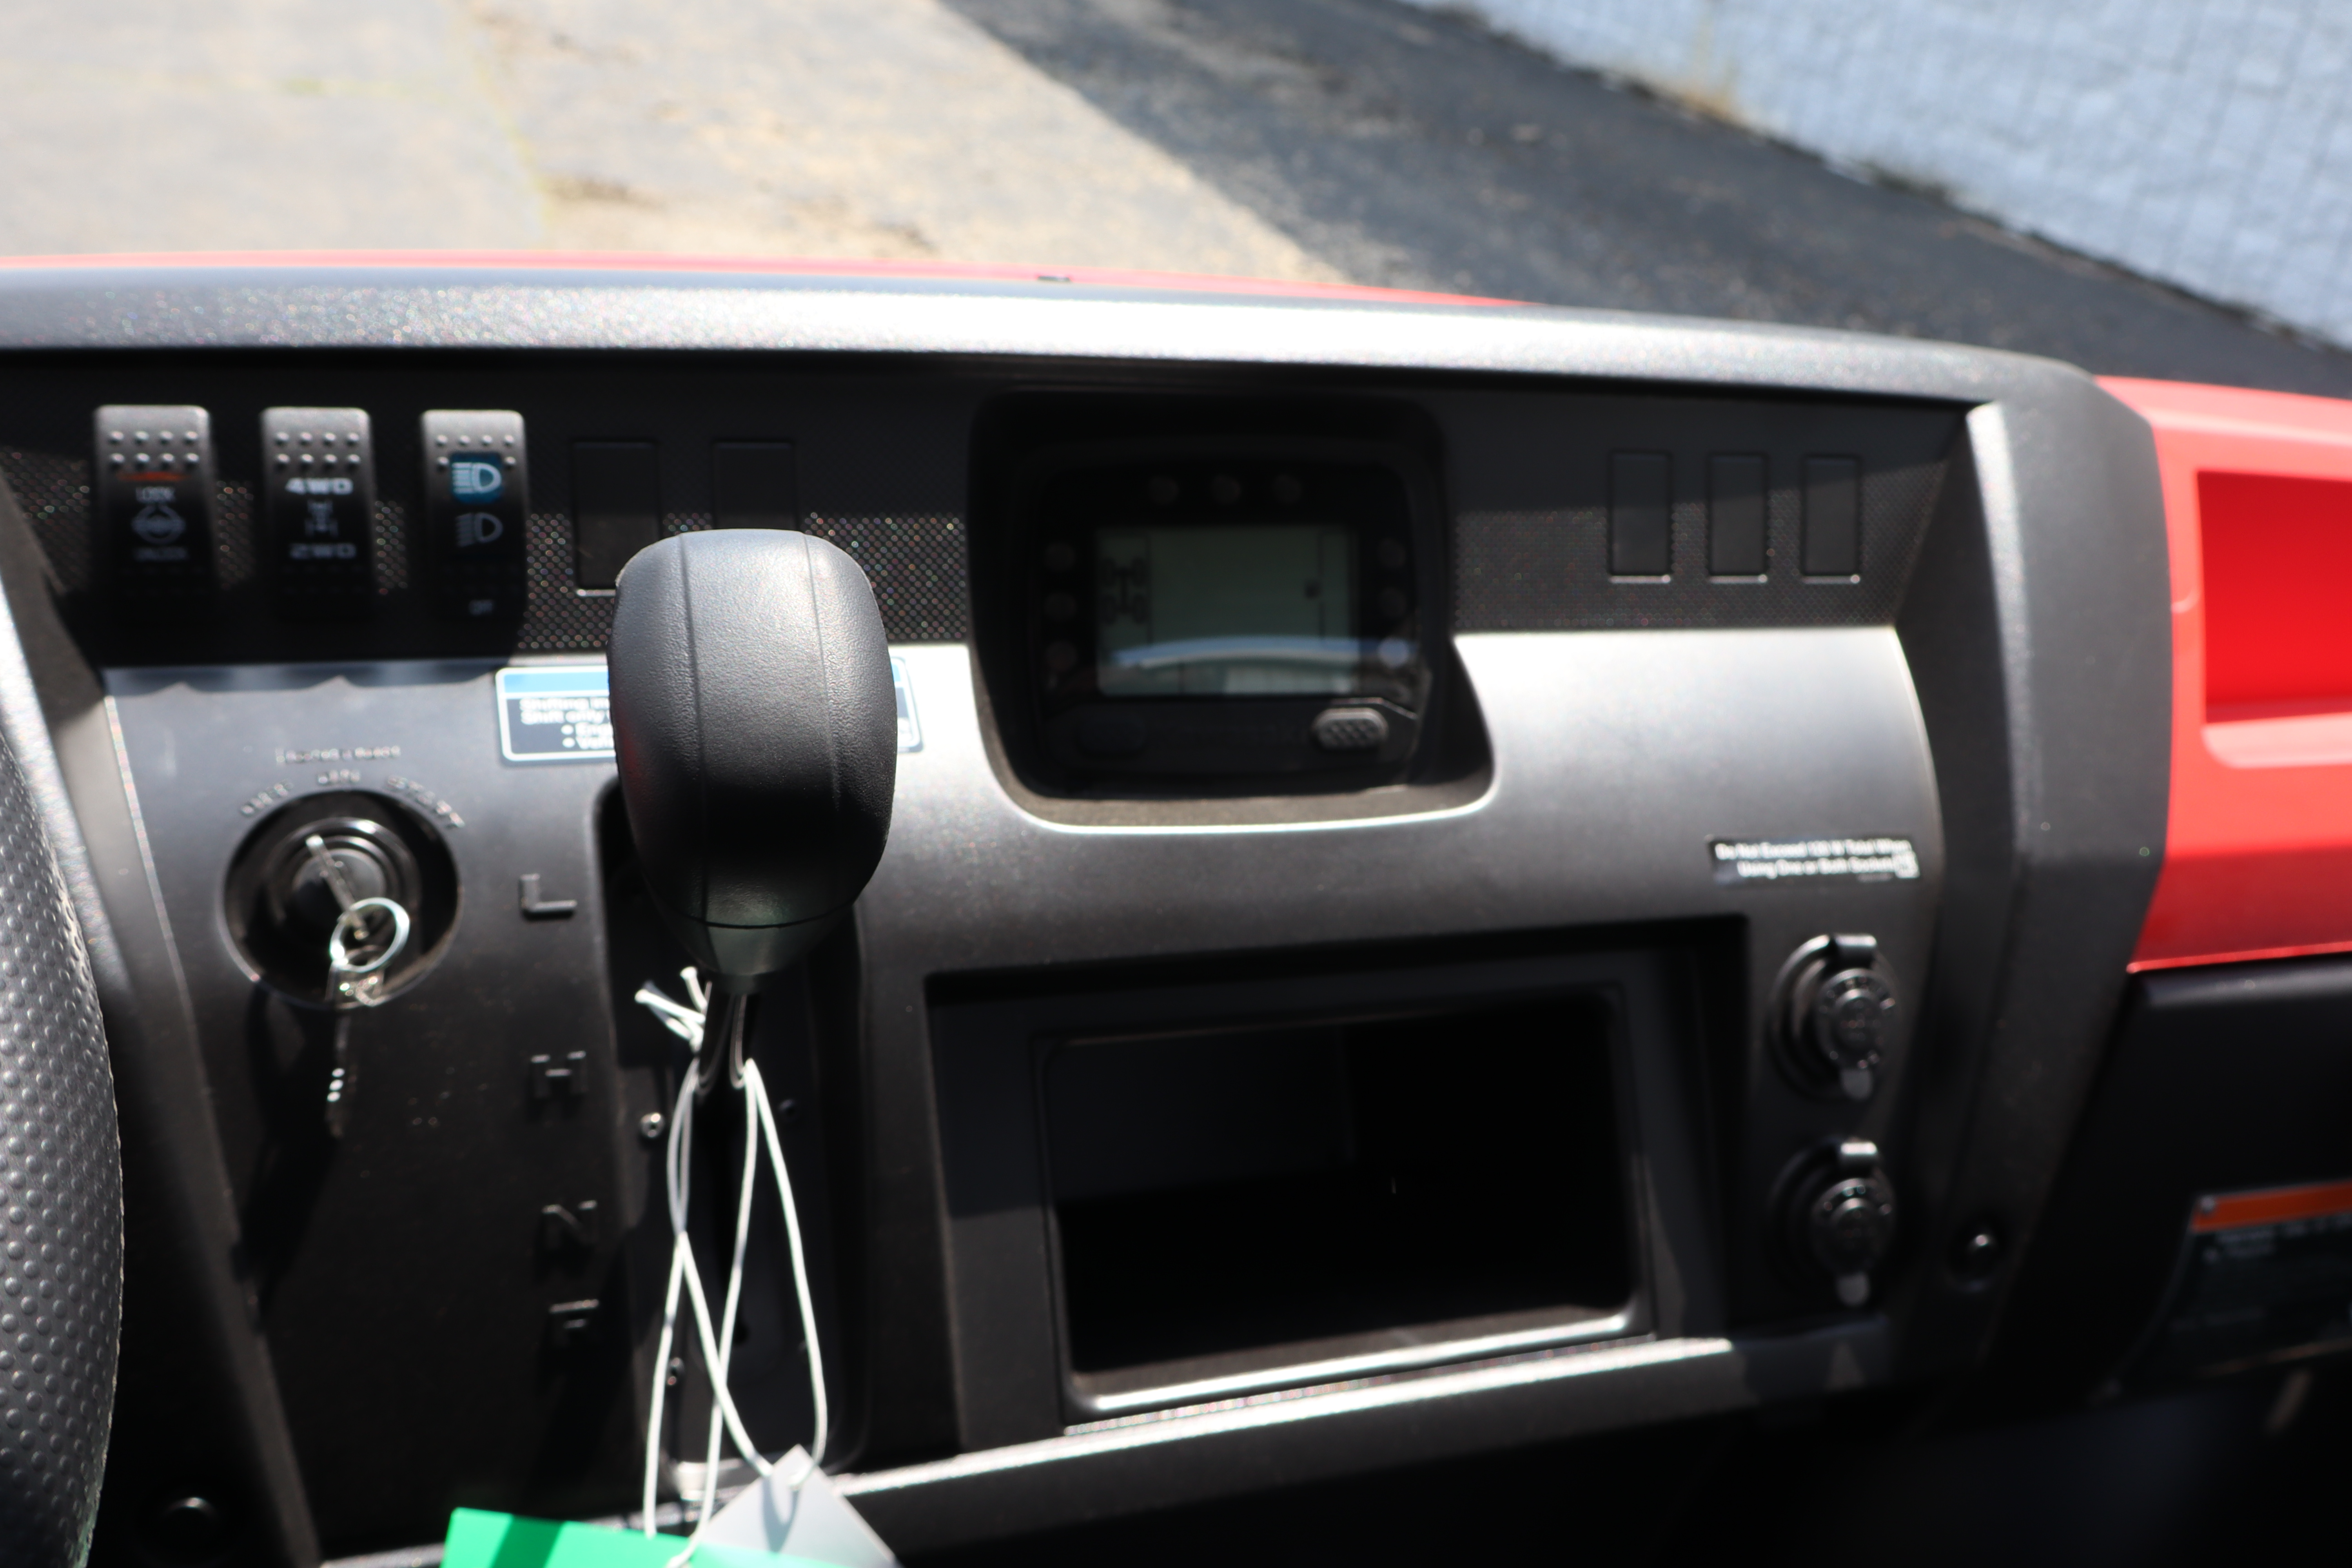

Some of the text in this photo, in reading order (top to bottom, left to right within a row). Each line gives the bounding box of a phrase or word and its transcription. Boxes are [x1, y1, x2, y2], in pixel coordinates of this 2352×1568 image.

[285, 477, 354, 495] 4WD
[519, 873, 577, 914] L
[531, 1051, 587, 1098] H
[542, 1200, 598, 1248] N
